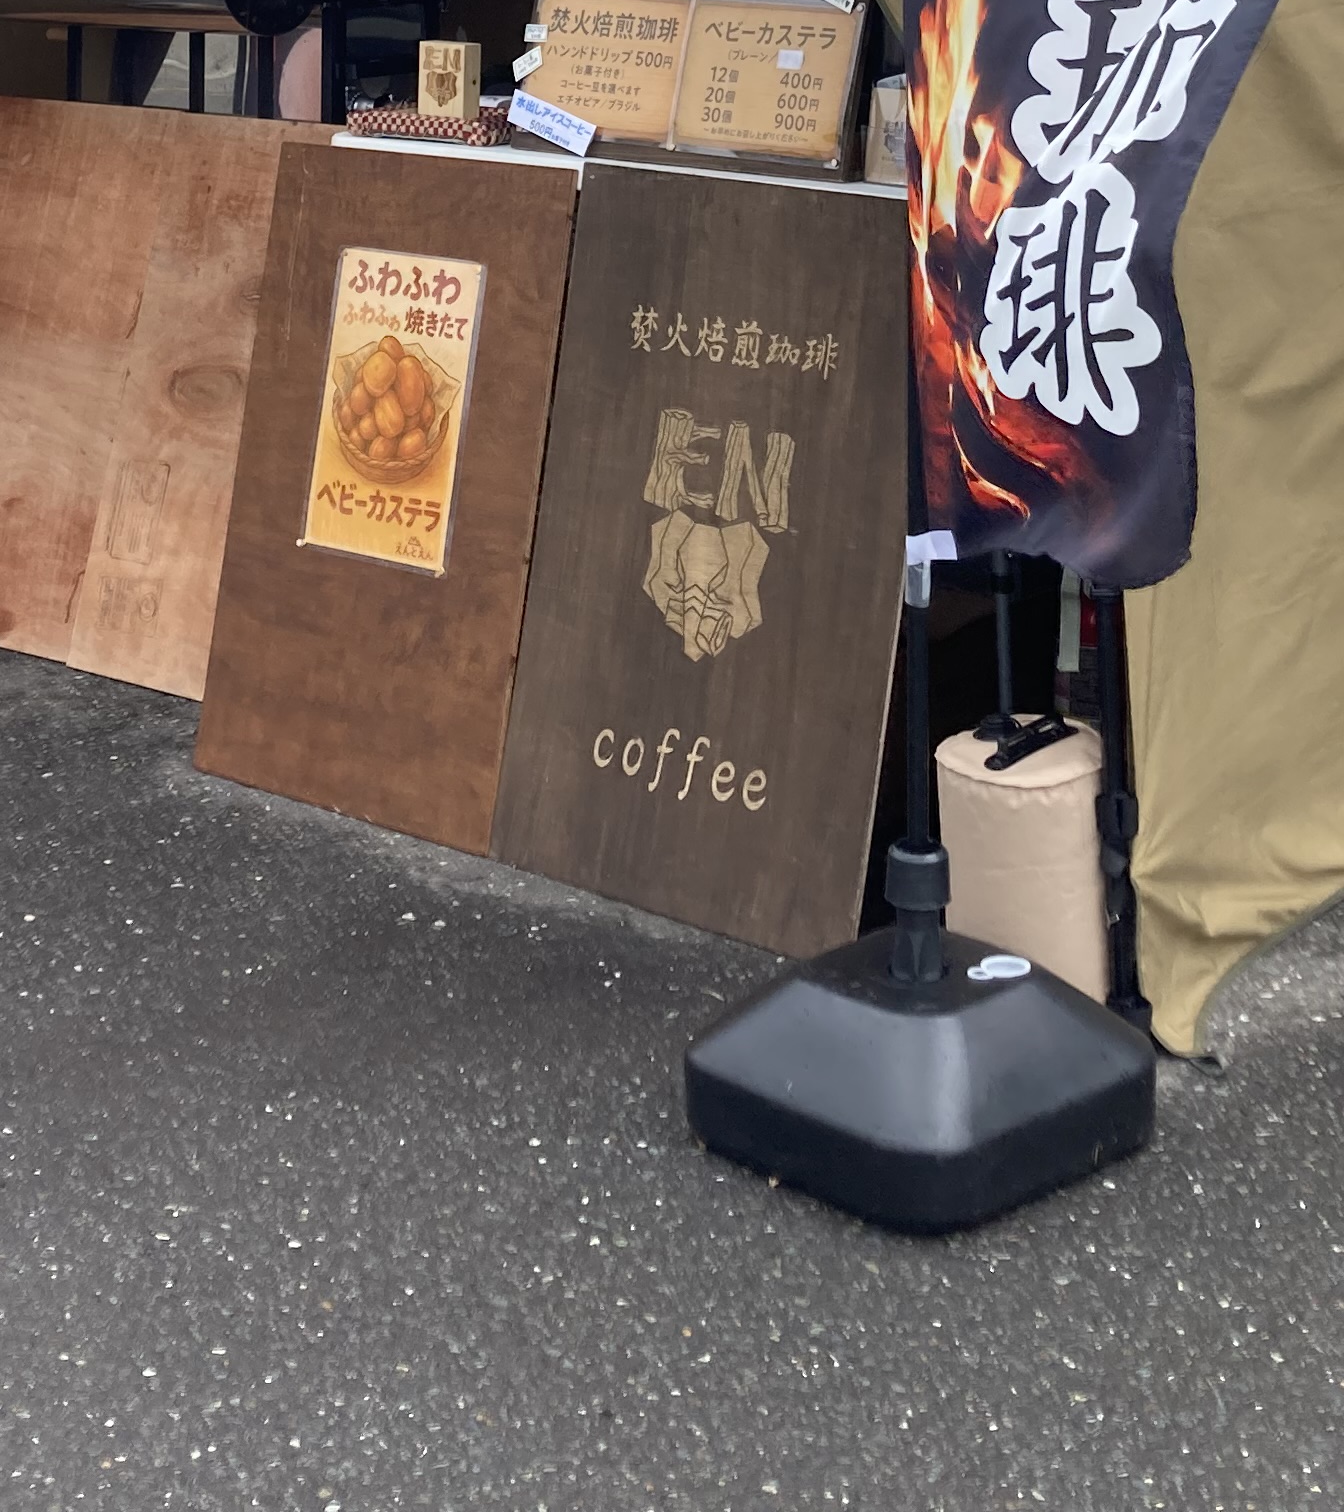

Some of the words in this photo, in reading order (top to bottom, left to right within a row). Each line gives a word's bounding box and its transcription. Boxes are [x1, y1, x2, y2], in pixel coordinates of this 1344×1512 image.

[548, 6, 680, 44] 焚火焙煎珈琲
[705, 21, 837, 50] ベビーカステラ
[422, 45, 462, 74] EN
[635, 50, 674, 70] 500円
[710, 66, 739, 84] 12個
[780, 71, 823, 91] 400円
[516, 96, 592, 136] 水出しアイスコーヒー
[704, 86, 736, 104] 20個
[777, 93, 820, 112] 600円
[701, 106, 733, 124] 30個
[774, 113, 817, 132] 900円
[348, 259, 462, 305] ふわふわ
[342, 300, 401, 333] ふわふわ
[404, 305, 469, 342] 焼きたて
[629, 304, 841, 381] 焚火焙煎珈琲
[642, 408, 796, 534] EN
[317, 479, 443, 533] ベビーカステラ
[592, 727, 768, 811] coffee
